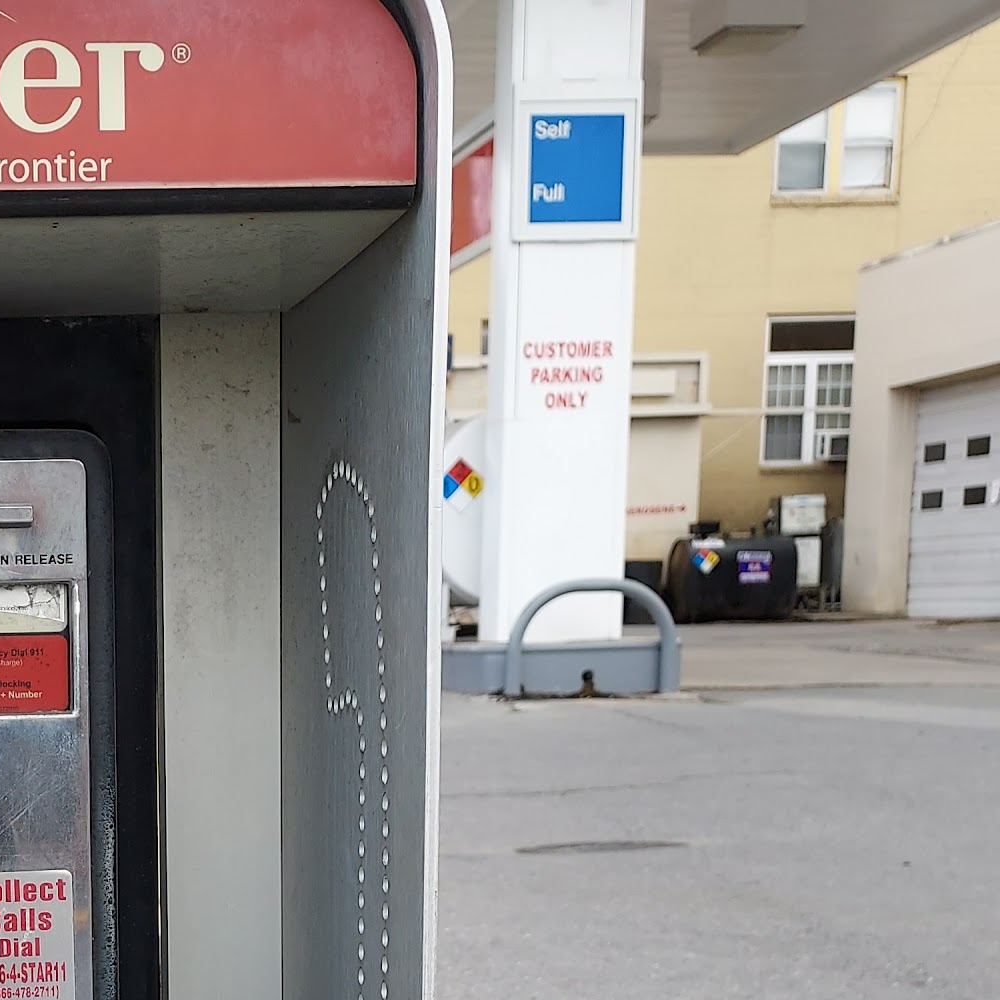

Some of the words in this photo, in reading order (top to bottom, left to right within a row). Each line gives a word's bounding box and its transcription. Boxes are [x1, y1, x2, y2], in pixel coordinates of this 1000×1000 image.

[535, 120, 572, 140] Self
[533, 182, 565, 202] Full
[523, 340, 613, 359] CUSTOMER
[530, 366, 603, 382] PARKING
[545, 392, 587, 409] ONLY
[15, 554, 74, 565] RELEASE
[8, 690, 42, 699] Number
